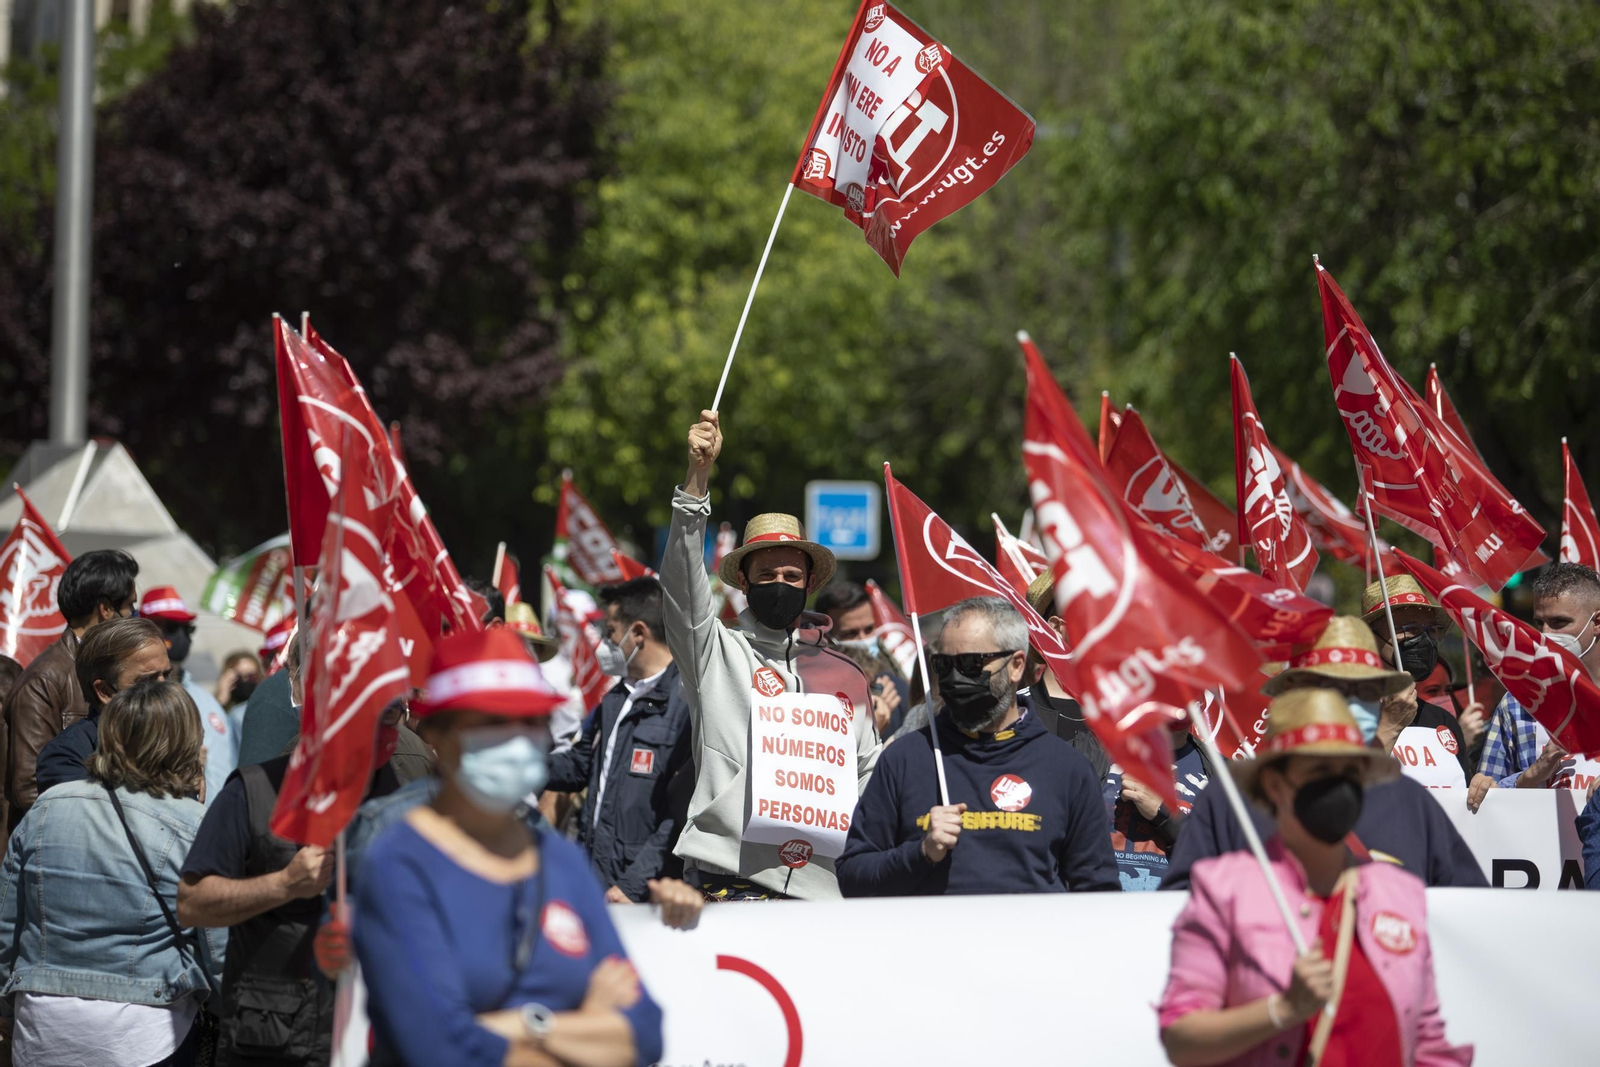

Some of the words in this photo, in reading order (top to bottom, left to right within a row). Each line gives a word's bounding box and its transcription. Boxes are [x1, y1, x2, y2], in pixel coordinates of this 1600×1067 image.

[864, 37, 890, 67] NO
[882, 55, 903, 78] A
[855, 85, 884, 121] ERE
[759, 705, 785, 723] NO
[791, 707, 848, 735] SOMOS
[762, 733, 846, 767] NÚMEROS
[1423, 745, 1437, 767] A
[775, 769, 836, 795] SOMOS
[758, 798, 850, 832] PERSONAS
[783, 841, 812, 857] UGT
[1114, 851, 1125, 859] NO
[1125, 853, 1160, 863] BEGINNING
